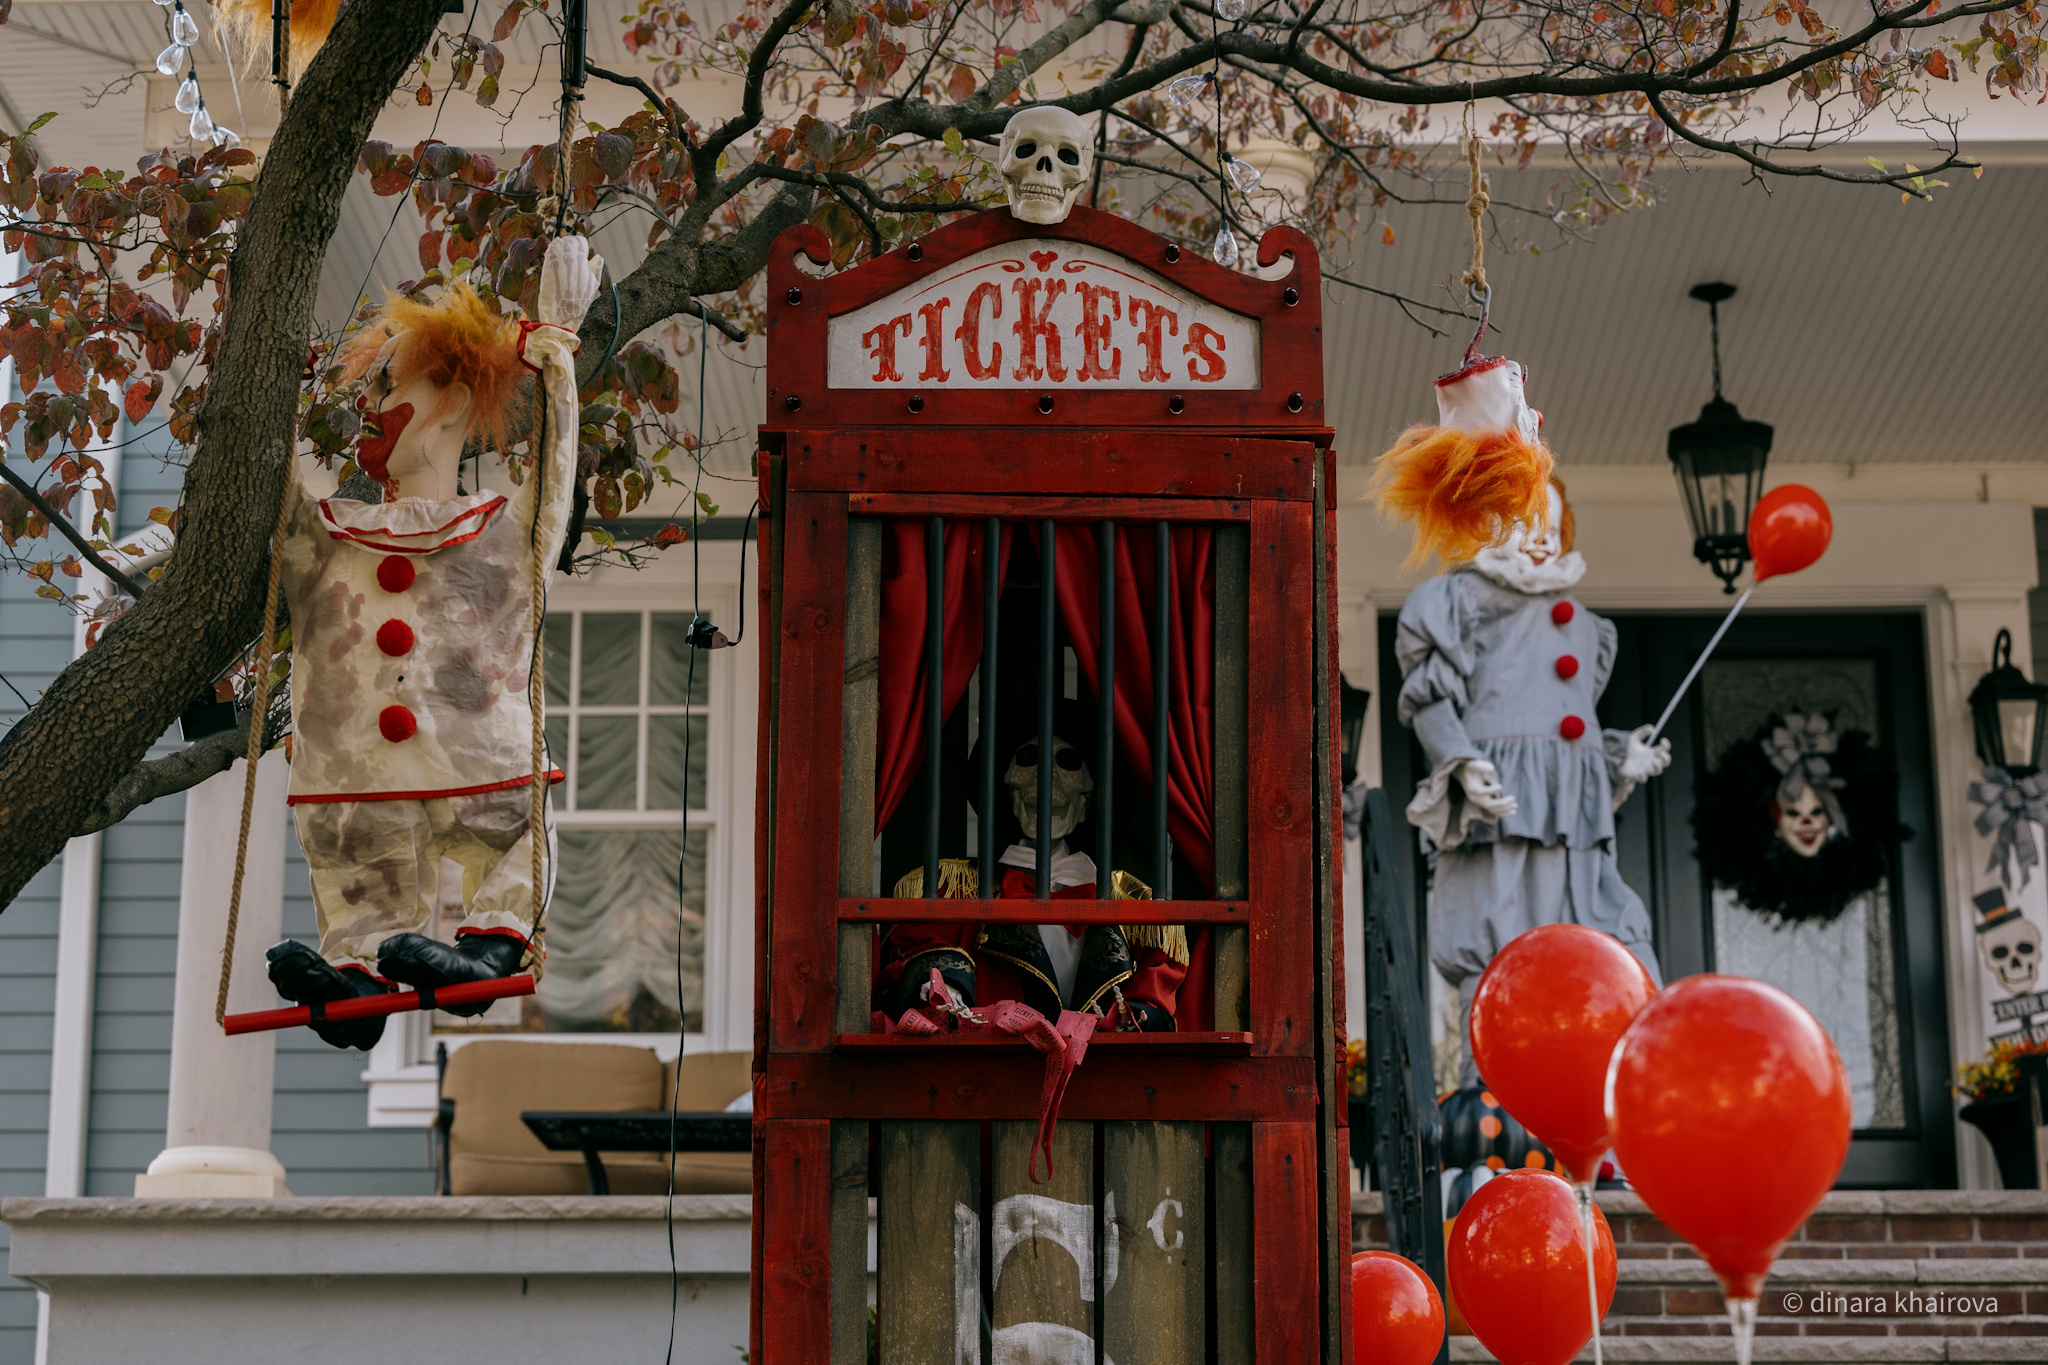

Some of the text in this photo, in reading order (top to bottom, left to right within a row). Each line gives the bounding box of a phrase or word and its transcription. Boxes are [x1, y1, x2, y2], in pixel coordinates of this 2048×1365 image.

[862, 277, 1226, 382] TICKETS
[1013, 1007, 1034, 1019] TICKET
[1996, 996, 2039, 1019] ENTER
[902, 1013, 918, 1033] TICKET
